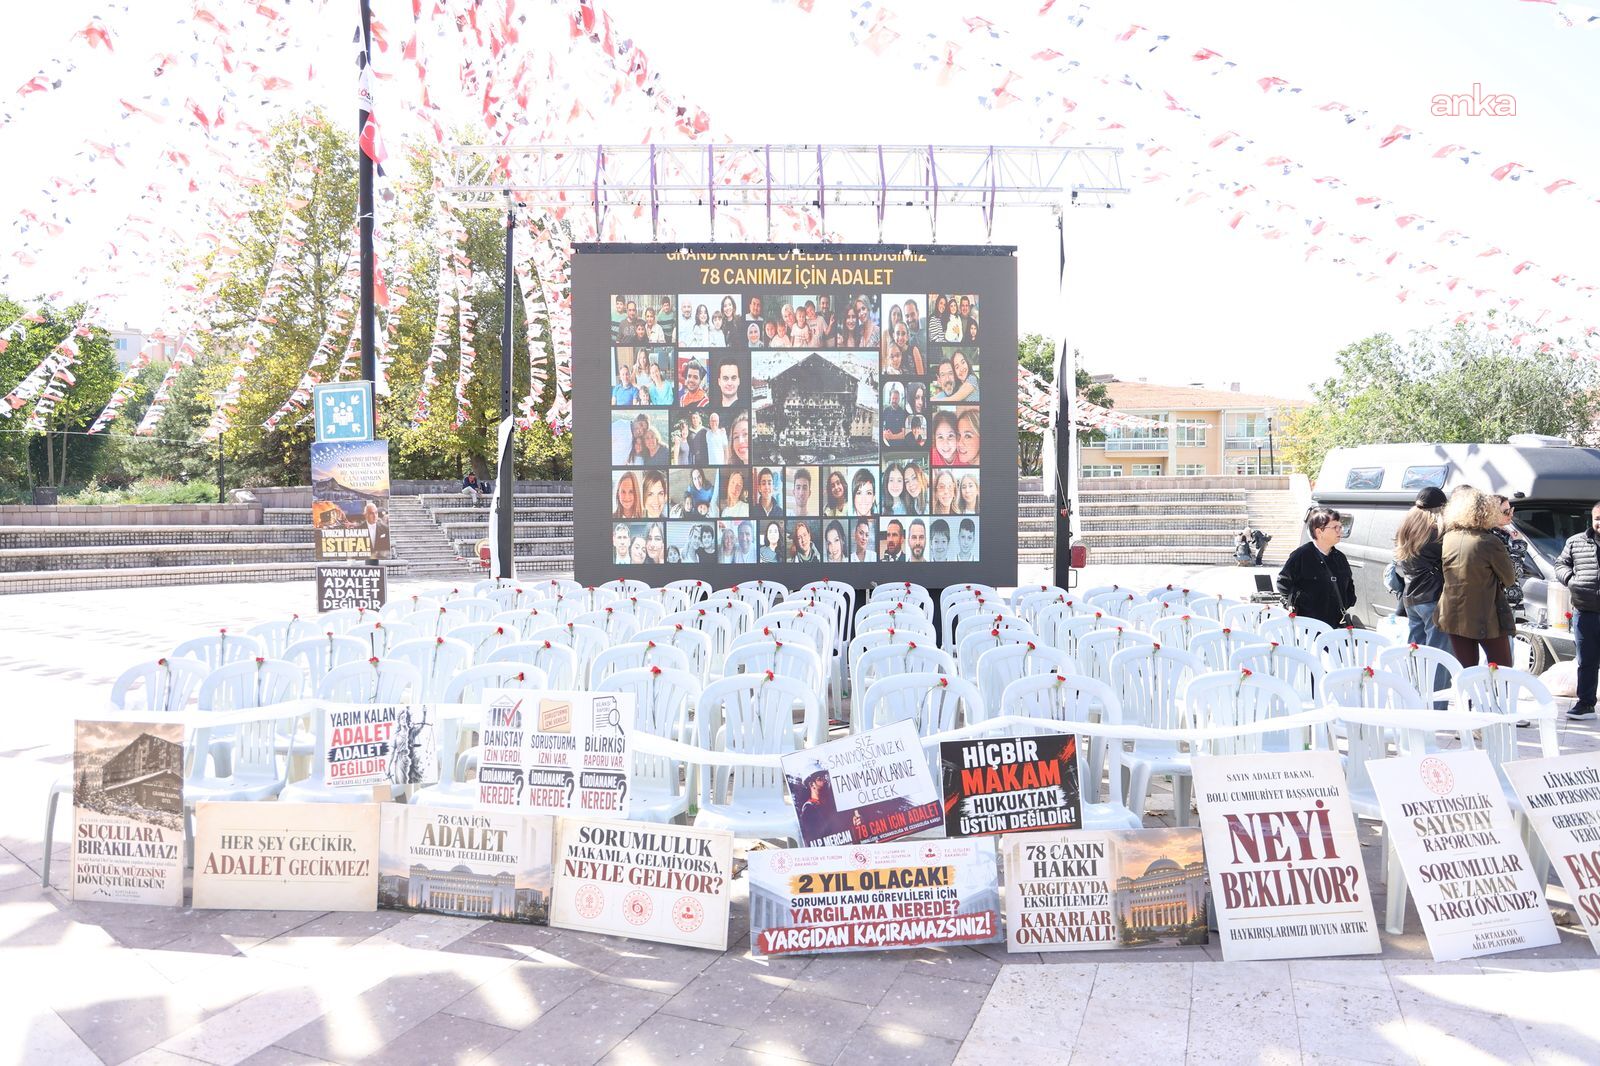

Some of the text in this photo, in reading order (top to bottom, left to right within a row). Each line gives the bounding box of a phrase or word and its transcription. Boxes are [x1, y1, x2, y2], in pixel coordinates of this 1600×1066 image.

[700, 264, 894, 288] 78 CANIMIZ İÇİN ADALET
[322, 537, 371, 552] İSTİFA!
[320, 568, 380, 578] YARIM KALAN
[324, 578, 380, 588] ADALET
[324, 588, 380, 599] ADALET
[323, 598, 381, 610] DEĞİLDİR
[330, 707, 396, 727] YARIM KALAN
[332, 722, 393, 747] ADALET
[484, 730, 524, 748] DANIŞTAY
[530, 734, 576, 750] SORUŞTURMA
[856, 735, 874, 748] SİZ
[334, 743, 382, 762] ADALET
[584, 736, 626, 754] BİLİRKİŞİ
[962, 738, 1039, 770] HİÇBİR
[484, 748, 522, 763] İZİN VERDİ.
[538, 752, 568, 765] İZNİ VAR.
[584, 754, 625, 768] RAPORU VAR.
[861, 760, 876, 770] HEP
[331, 758, 386, 777] DEĞİLDİR
[481, 768, 514, 784] İDDİANAME
[832, 759, 916, 794] TANIMADIKLARINIZ
[1226, 772, 1250, 782] SAYIN
[1252, 772, 1282, 780] ADALET
[1544, 766, 1600, 788] LİYAKATSİZ
[531, 770, 564, 786] İDDİANAME
[582, 773, 617, 790] İDDİANAME
[962, 759, 1062, 796] MAKAM
[858, 784, 899, 804] ÖLECEK
[974, 790, 1058, 814] HUKUKTAN
[1206, 785, 1340, 803] BOLU CUMHURİYET BAŞSAVCILIĞI
[1527, 792, 1558, 809] KAMU
[1401, 792, 1493, 817] DENETİMSİZLİK
[438, 815, 491, 828] 78 CAN İÇİN
[856, 802, 938, 840] 78 CAN İÇİN ADALET
[960, 807, 1076, 834] ÜSTÜN DEĞİLDİR!
[1412, 810, 1494, 838] SAYIŞTAY
[1552, 811, 1598, 829] GEREKEN
[78, 824, 164, 842] SUÇLULARA
[422, 824, 508, 852] ADALET
[1222, 800, 1341, 864] NEYİ
[1570, 824, 1600, 844] VERİL
[78, 840, 178, 860] BIRAKILAMAZ!
[221, 834, 356, 853] HER ŞEY GECİKİR,
[579, 826, 712, 858] SORUMLULUK
[1026, 843, 1104, 860] 78 CANIN
[204, 852, 370, 876] ADALET GECİKMEZ!
[410, 846, 518, 864] YARGITAY'DA TECELLİ EDECEK!
[568, 845, 723, 876] MAKAMLA GELMİYORSA,
[77, 863, 166, 878] KÖTÜLÜK MÜZESİNE
[563, 860, 724, 894] NEYLE GELİYOR?
[1034, 860, 1098, 878] HAKKI
[1418, 854, 1524, 884] SORUMLULAR
[1564, 851, 1600, 890] FAC
[77, 874, 164, 889] DÖNÜŞTÜRÜLSÜN!
[799, 866, 948, 893] 2 YIL OLACAK!
[1018, 880, 1108, 896] YARGITAY'DA
[1220, 862, 1359, 910] BEKLİYOR?
[1438, 874, 1518, 900] NE ZAMAN
[792, 886, 957, 908] SORUMLU KAMU GÖREVLİLERİ İÇİN
[1024, 894, 1108, 908] EKSİLTİLEMEZ!
[1427, 890, 1539, 922] YARGI ÖNÜNDE?
[790, 900, 960, 924] YARGILAMA NEREDE?
[1021, 910, 1111, 928] KARARLAR
[1578, 893, 1600, 926] SO
[764, 912, 991, 952] YARGIDAN KAÇIRAMAZSINIZ!
[1016, 926, 1116, 944] ONANMALI!
[1230, 921, 1368, 941] HAYKIRIŞLARIMIZI DUYUN ARTIK!
[1475, 928, 1518, 942] KARTALKAYA
[1472, 936, 1526, 950] AİLE PLATFORMU
